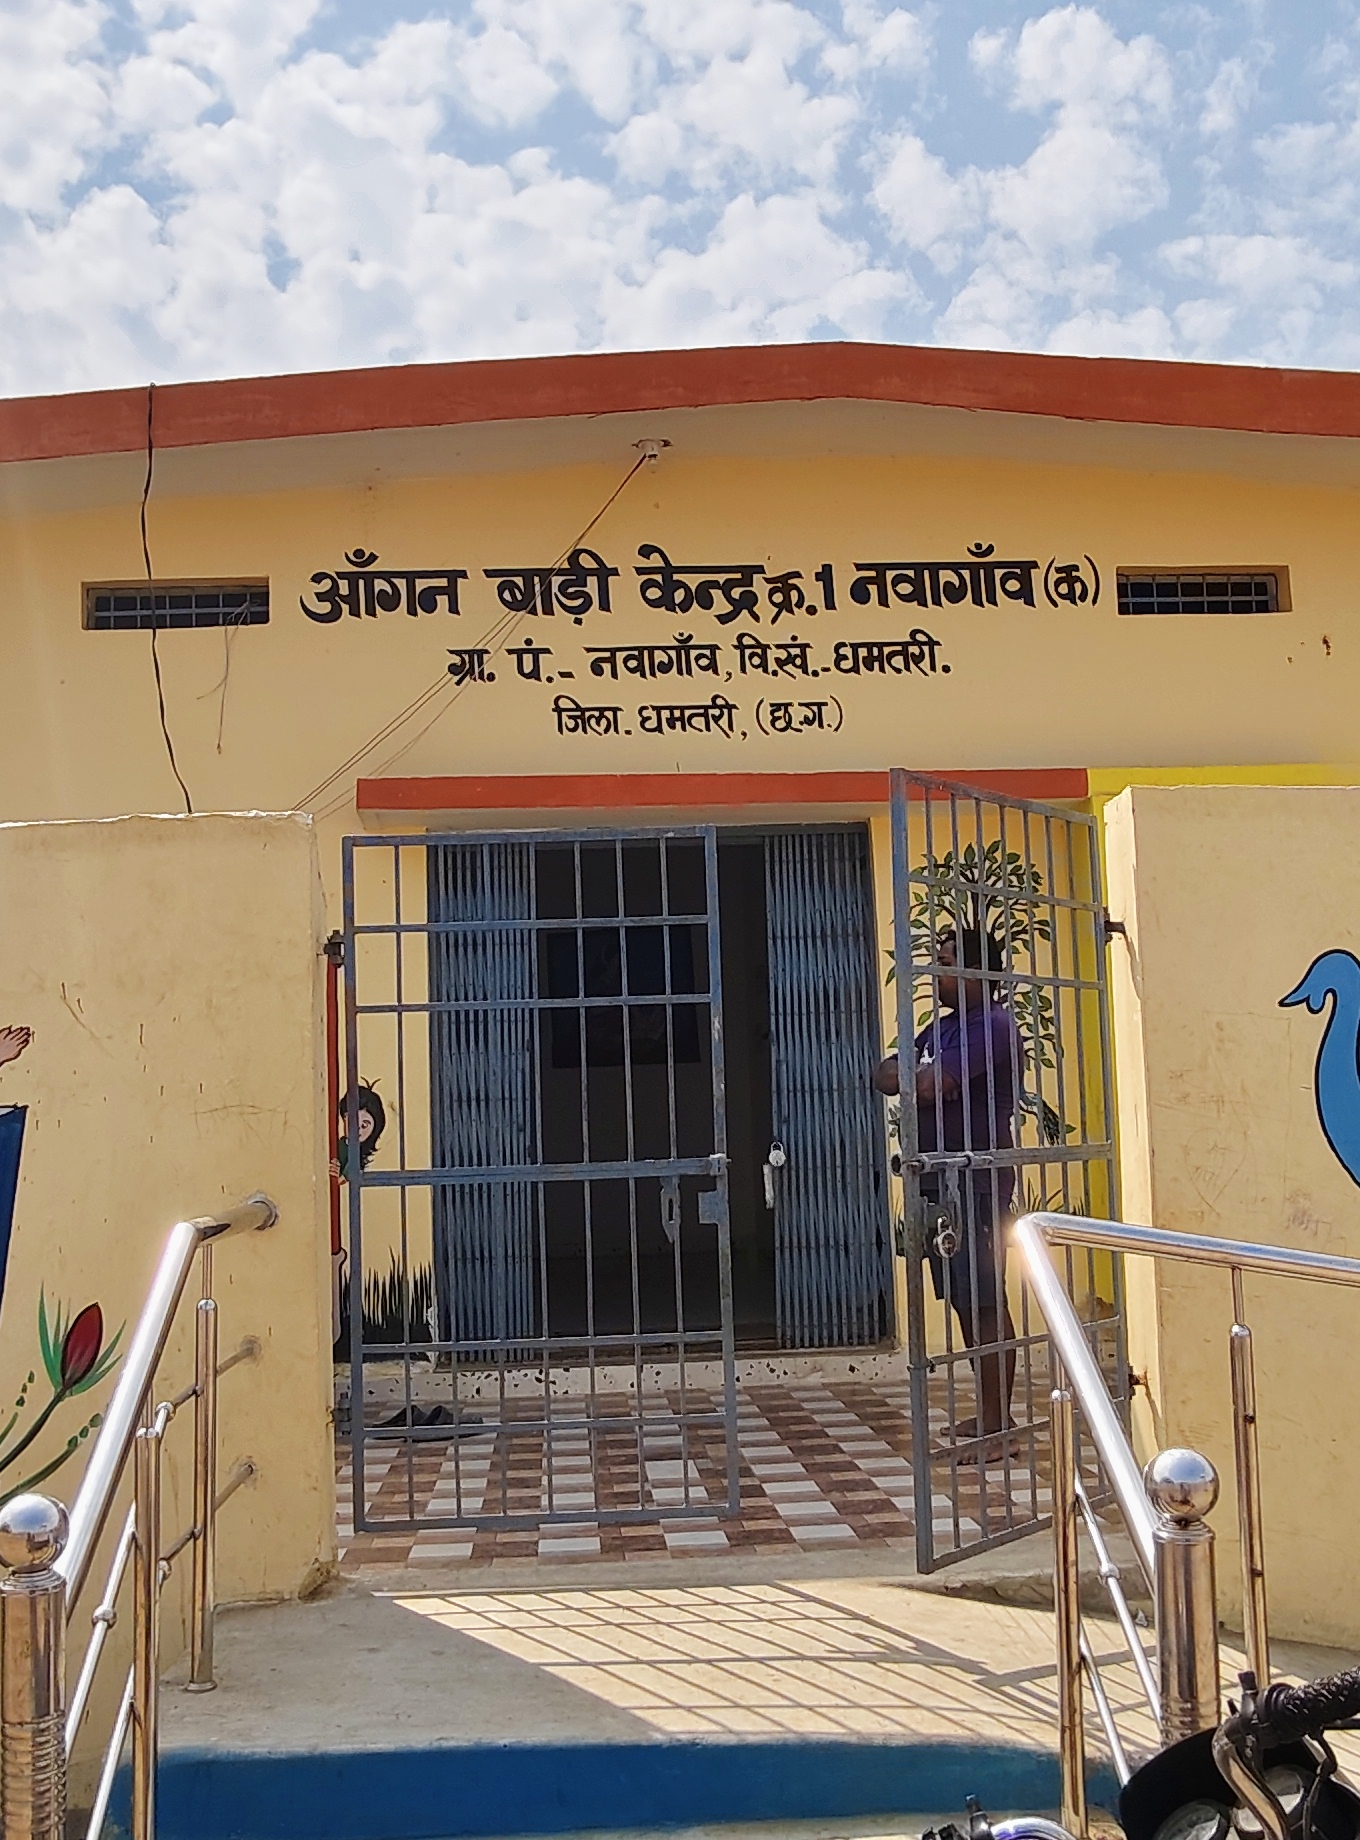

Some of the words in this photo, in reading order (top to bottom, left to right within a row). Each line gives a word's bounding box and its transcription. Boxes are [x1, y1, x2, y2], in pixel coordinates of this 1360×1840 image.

[299, 548, 469, 624] आँगन
[482, 548, 620, 627] बाड़ी
[632, 543, 766, 626] केन्द्र
[849, 542, 1040, 609] नवागाँव
[1042, 553, 1101, 609] (क)
